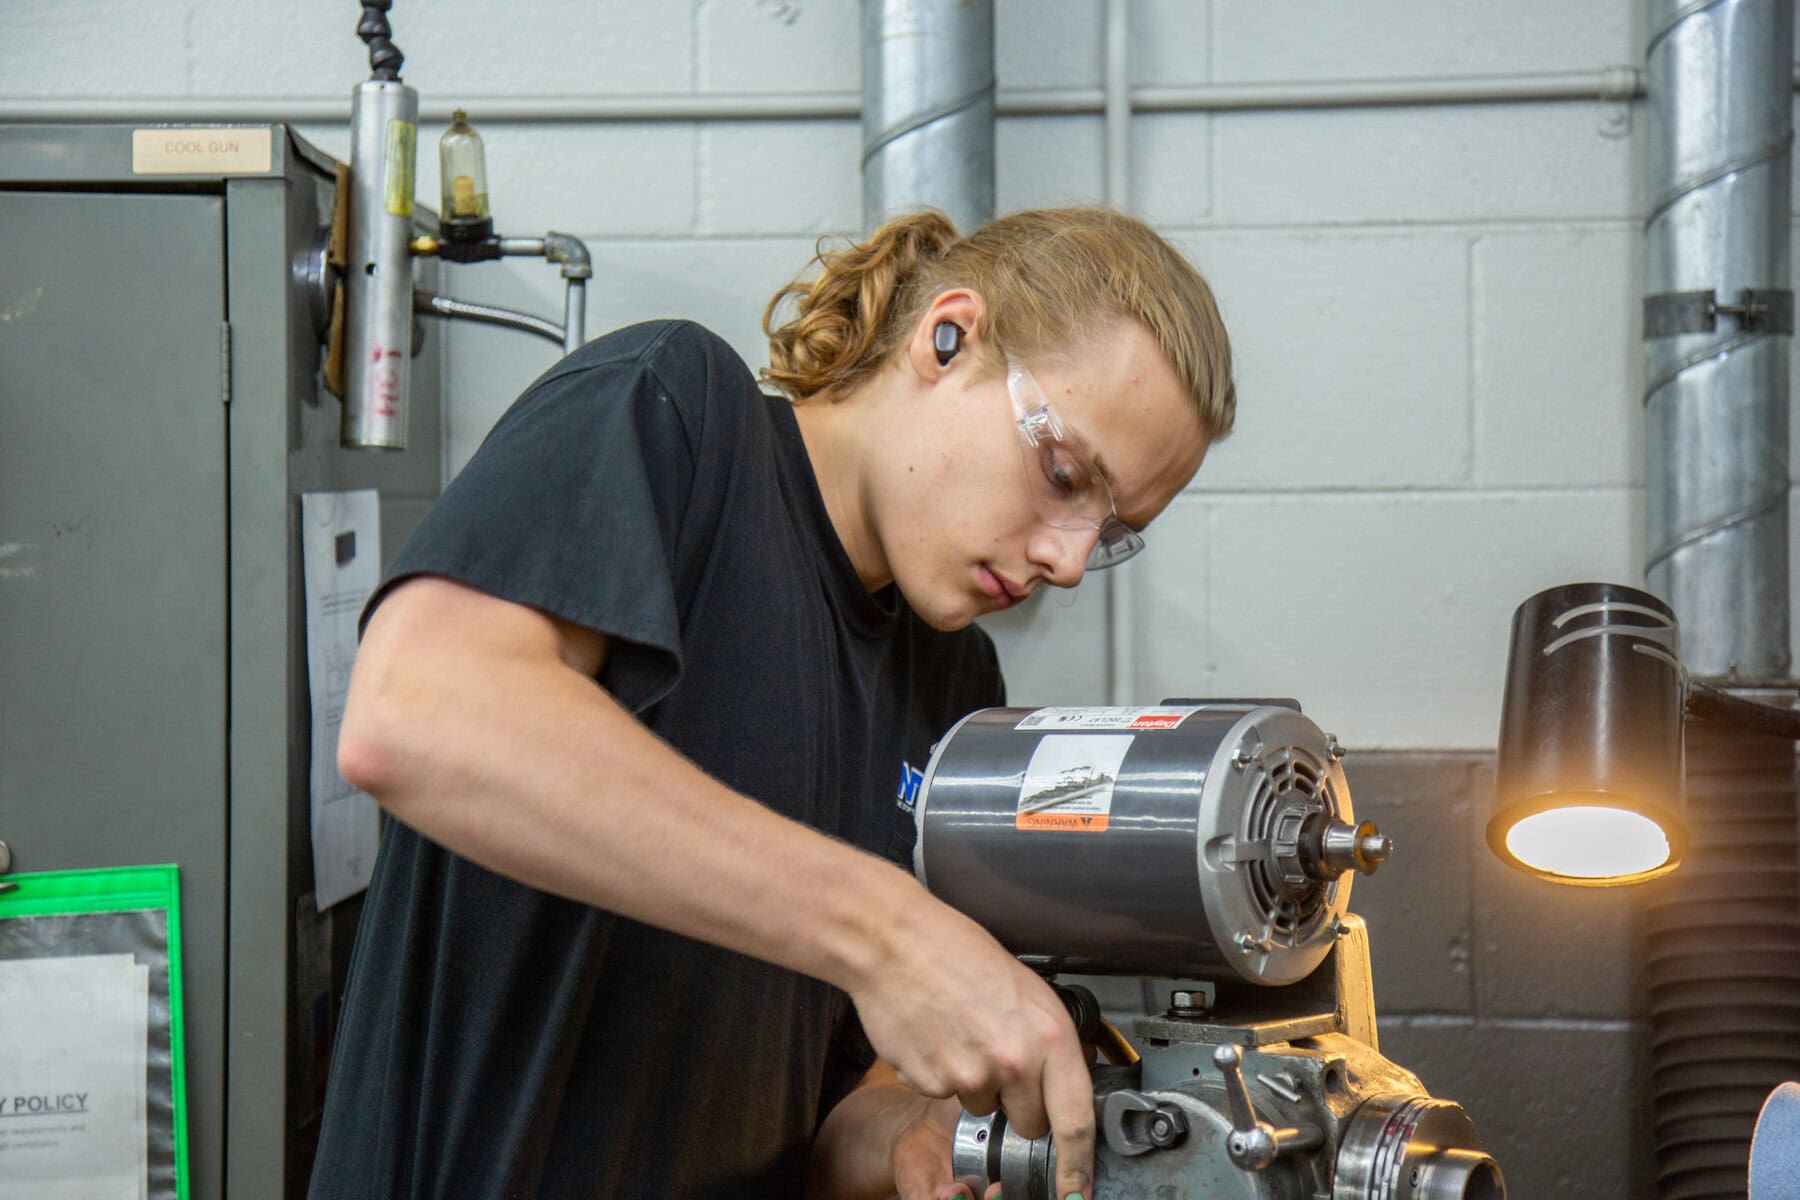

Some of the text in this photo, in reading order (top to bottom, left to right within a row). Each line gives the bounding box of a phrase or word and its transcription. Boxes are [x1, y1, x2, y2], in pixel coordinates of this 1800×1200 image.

[164, 141, 239, 154] COOL GUN
[1132, 719, 1177, 729] Dayton
[1027, 817, 1078, 829] WARNING
[14, 1093, 88, 1112] POLICY
